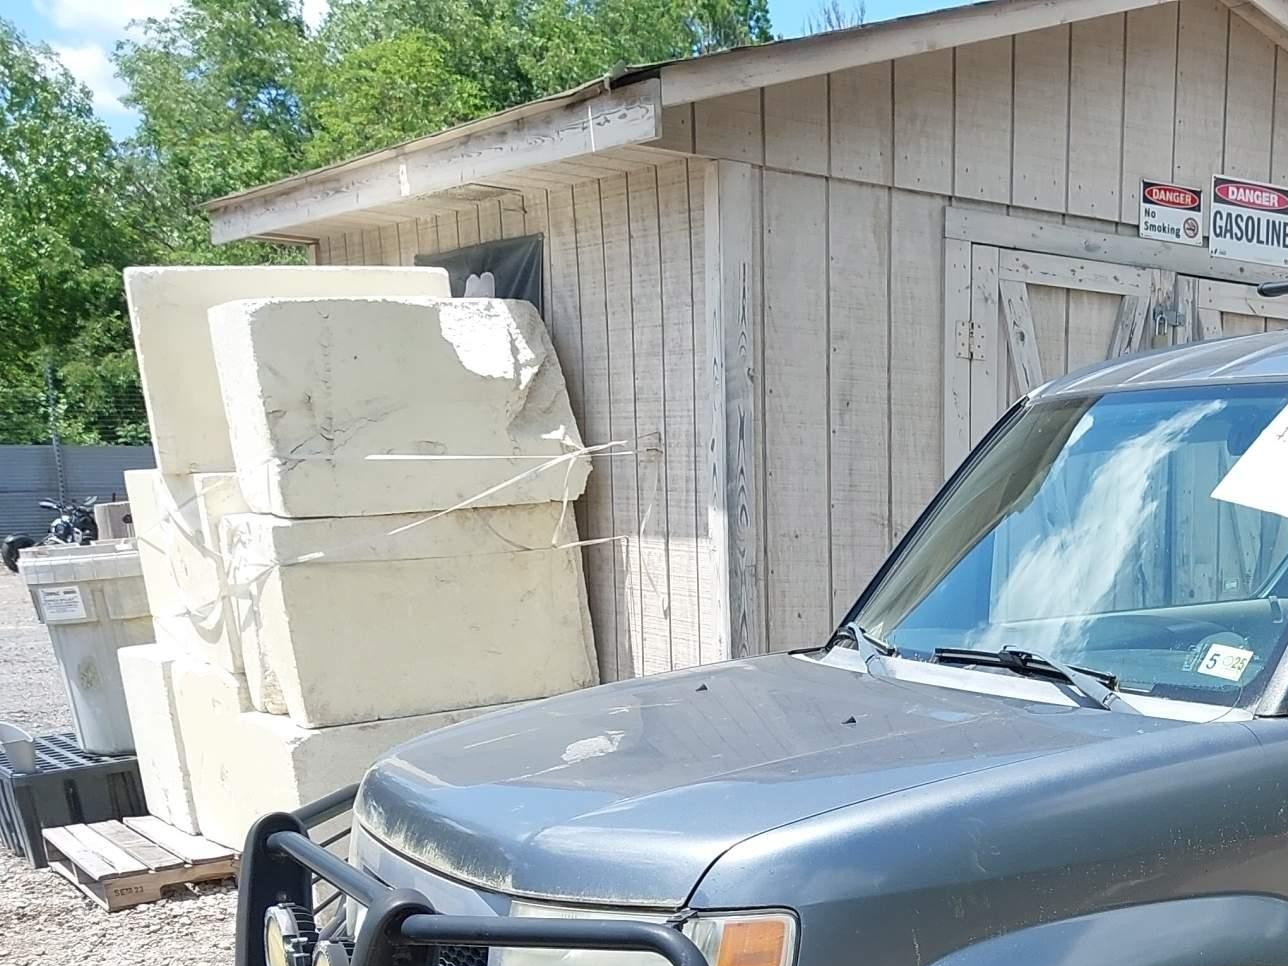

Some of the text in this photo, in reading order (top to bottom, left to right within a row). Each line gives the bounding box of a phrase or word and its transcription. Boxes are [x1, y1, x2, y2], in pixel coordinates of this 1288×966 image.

[1152, 188, 1192, 206] DANGER
[1228, 186, 1279, 207] DANGER
[1144, 208, 1156, 218] No
[1144, 221, 1180, 238] Smoking
[1205, 652, 1221, 670] 5
